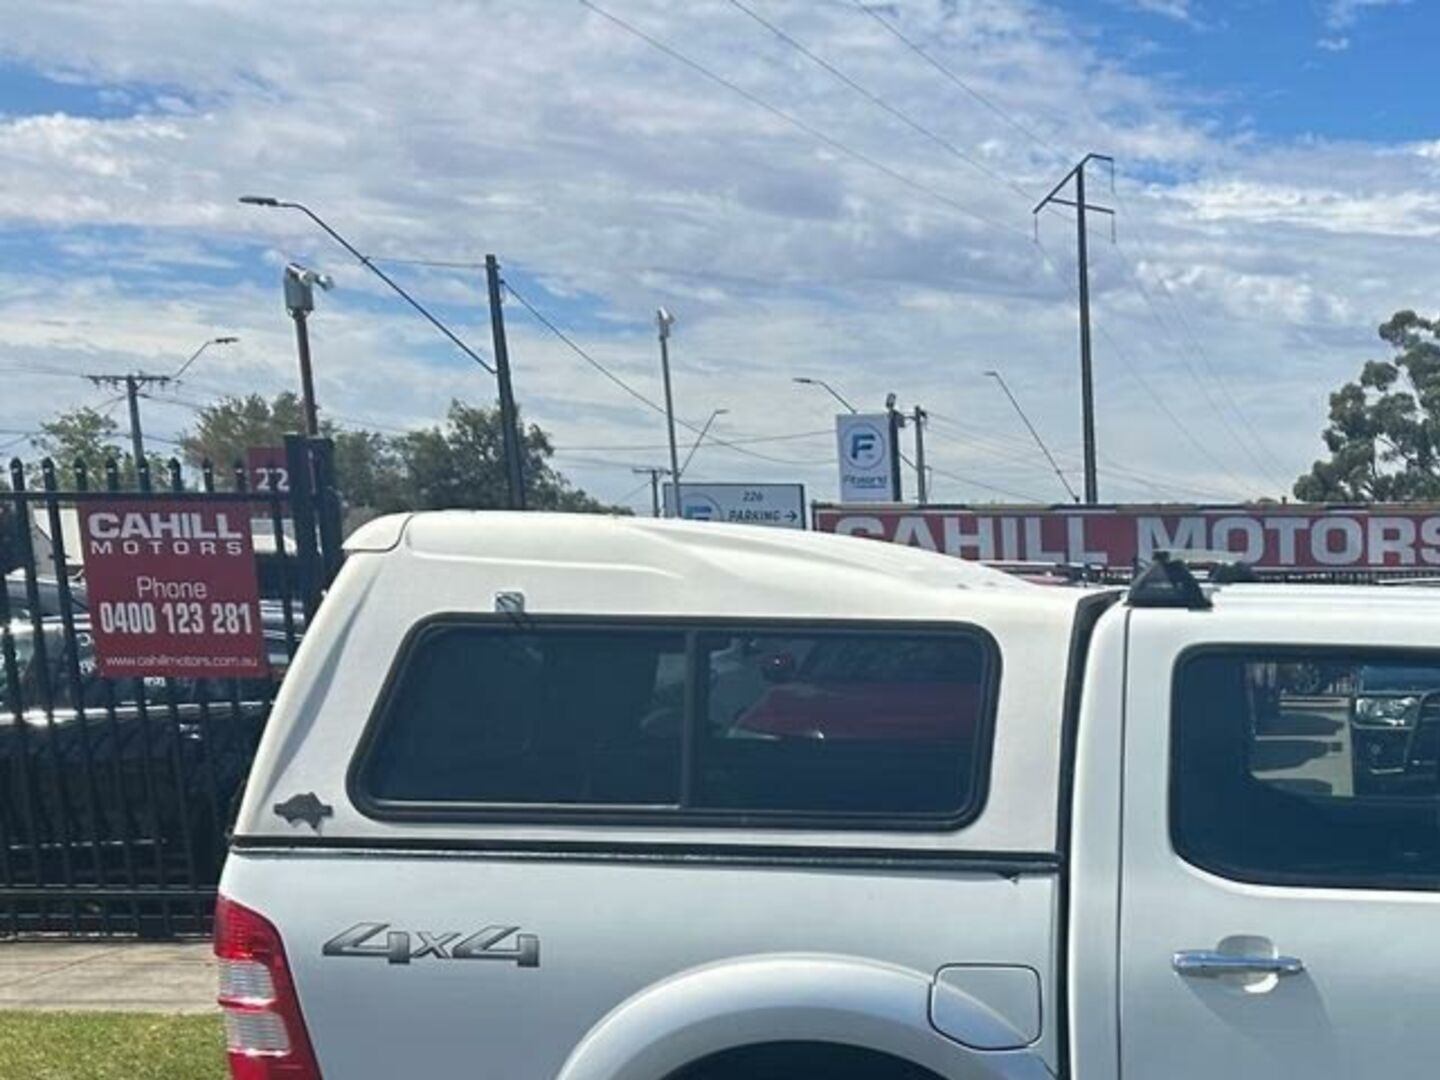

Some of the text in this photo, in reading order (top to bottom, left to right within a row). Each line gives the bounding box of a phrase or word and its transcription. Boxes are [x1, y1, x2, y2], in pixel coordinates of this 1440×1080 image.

[88, 512, 243, 539] CAHILL
[729, 509, 781, 522] PARKING
[91, 541, 243, 555] MOTORS
[136, 576, 208, 599] Phone
[101, 602, 253, 634] 0400 123 281
[322, 922, 540, 967] 4x4
